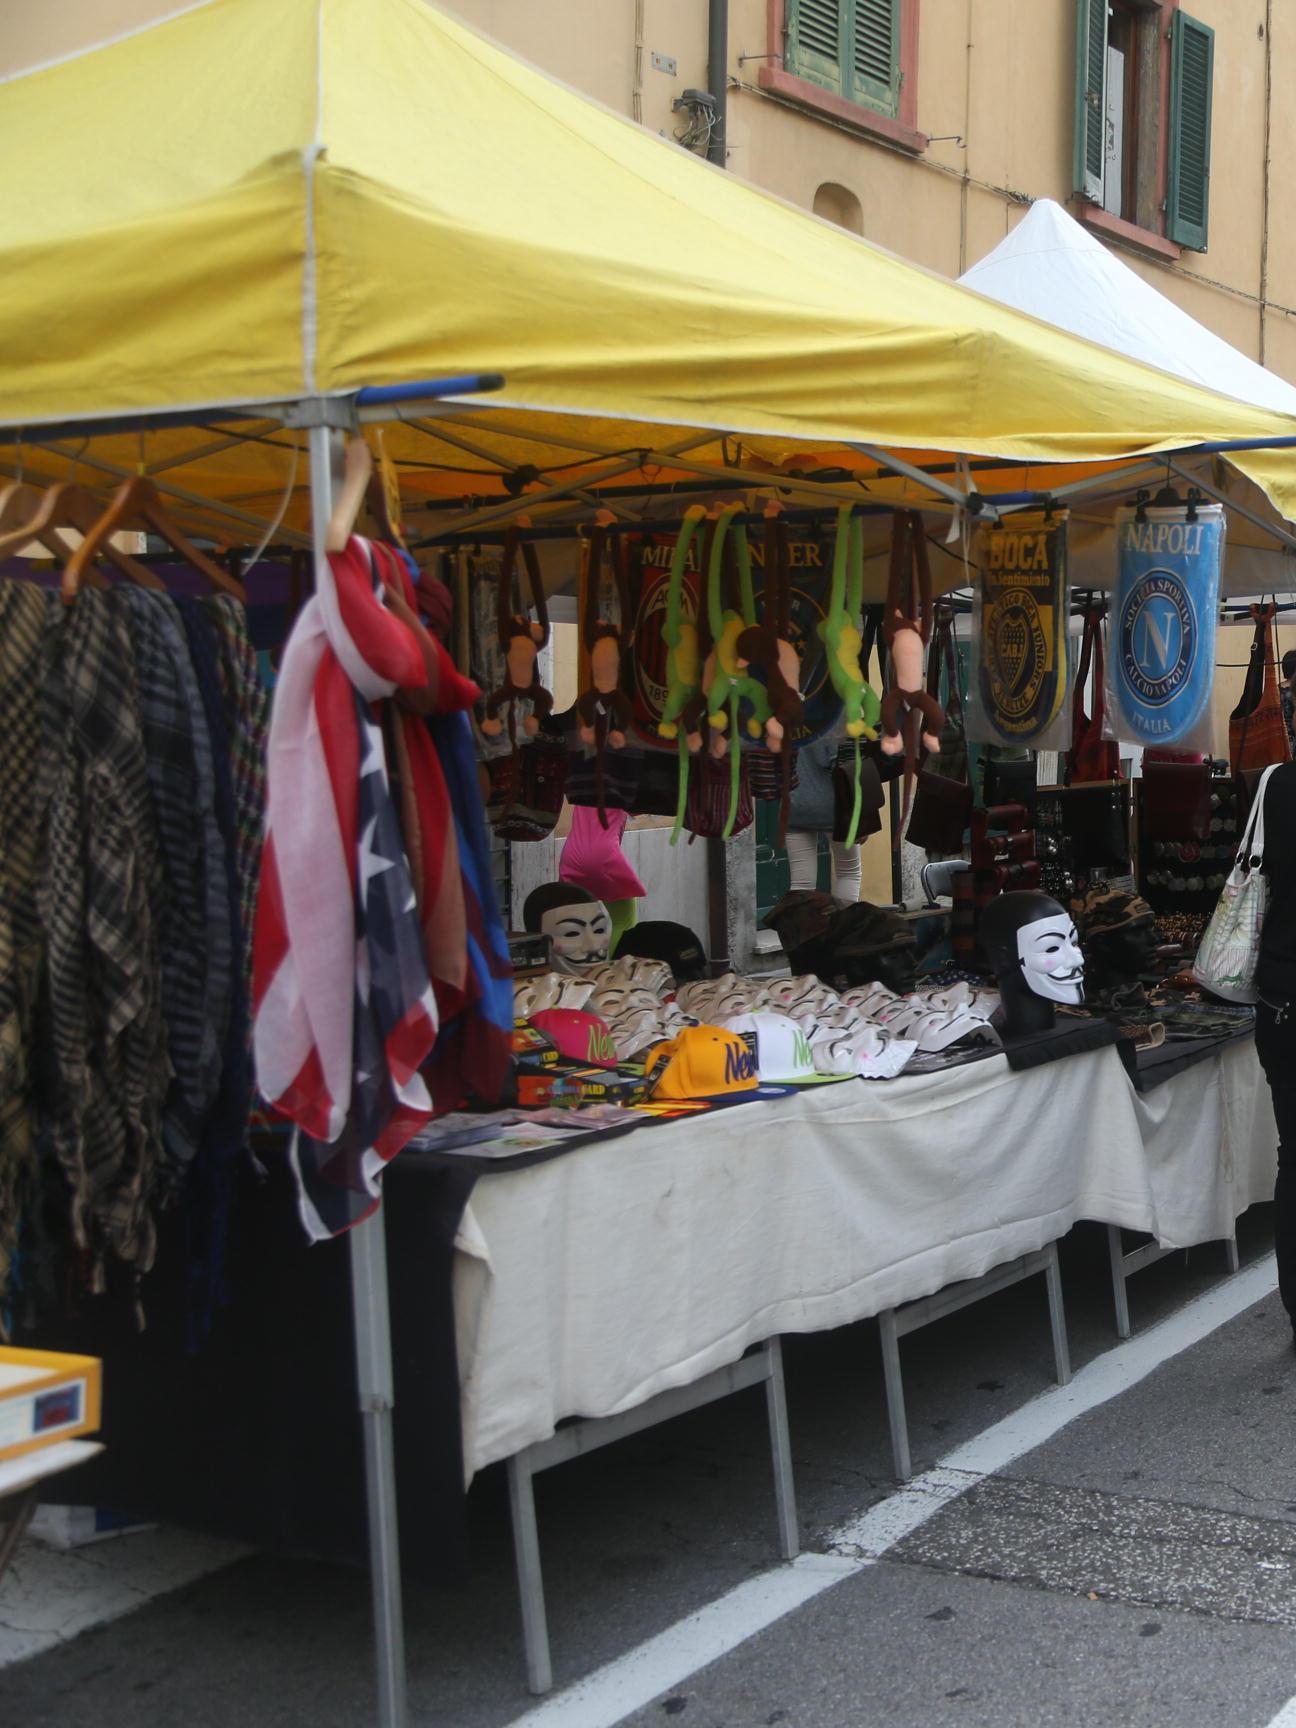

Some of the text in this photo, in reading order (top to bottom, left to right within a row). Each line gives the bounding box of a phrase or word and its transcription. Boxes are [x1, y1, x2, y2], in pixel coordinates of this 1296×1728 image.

[745, 542, 823, 568] NER
[990, 533, 1049, 570] BOCA
[1124, 523, 1204, 555] NAPOLI
[1157, 579, 1191, 635] SPORTIVA
[1139, 610, 1177, 670] N
[1125, 654, 1187, 697] CALCIO NAPOLI
[647, 685, 669, 702] 189
[1132, 711, 1172, 734] ITALIA
